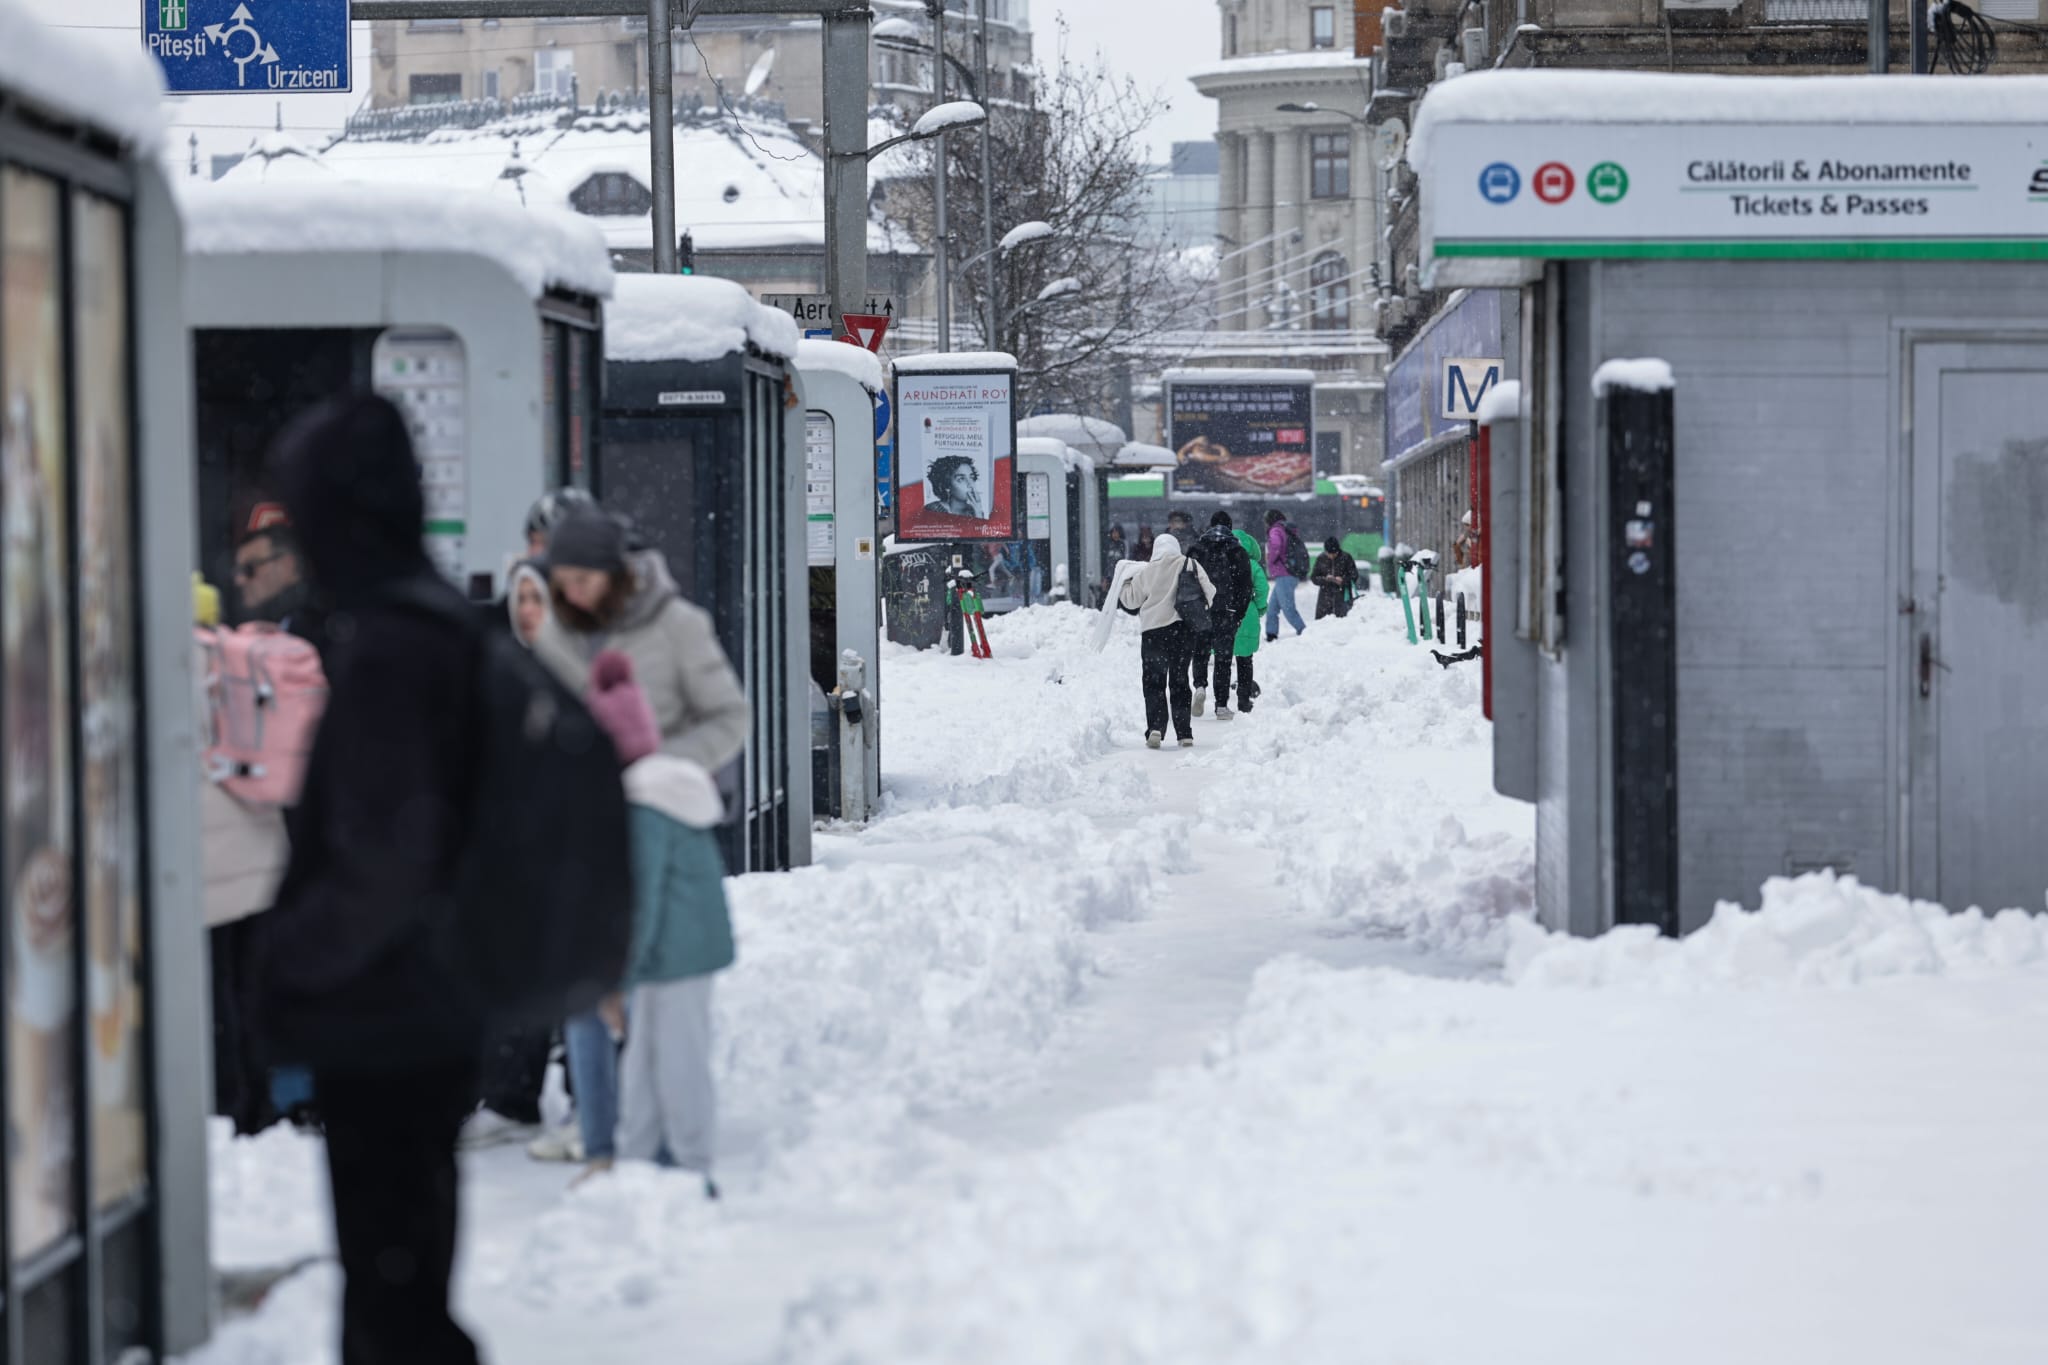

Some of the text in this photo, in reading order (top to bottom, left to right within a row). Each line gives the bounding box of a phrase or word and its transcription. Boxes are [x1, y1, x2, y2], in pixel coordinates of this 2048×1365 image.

[149, 33, 206, 61] Pitești
[267, 64, 338, 88] Urziceni
[1687, 160, 1972, 182] Călătorii & Abonamente
[1730, 194, 1929, 216] Tickets & Passes
[904, 388, 1008, 401] ARUNDHATI ROY
[1447, 365, 1499, 413] M
